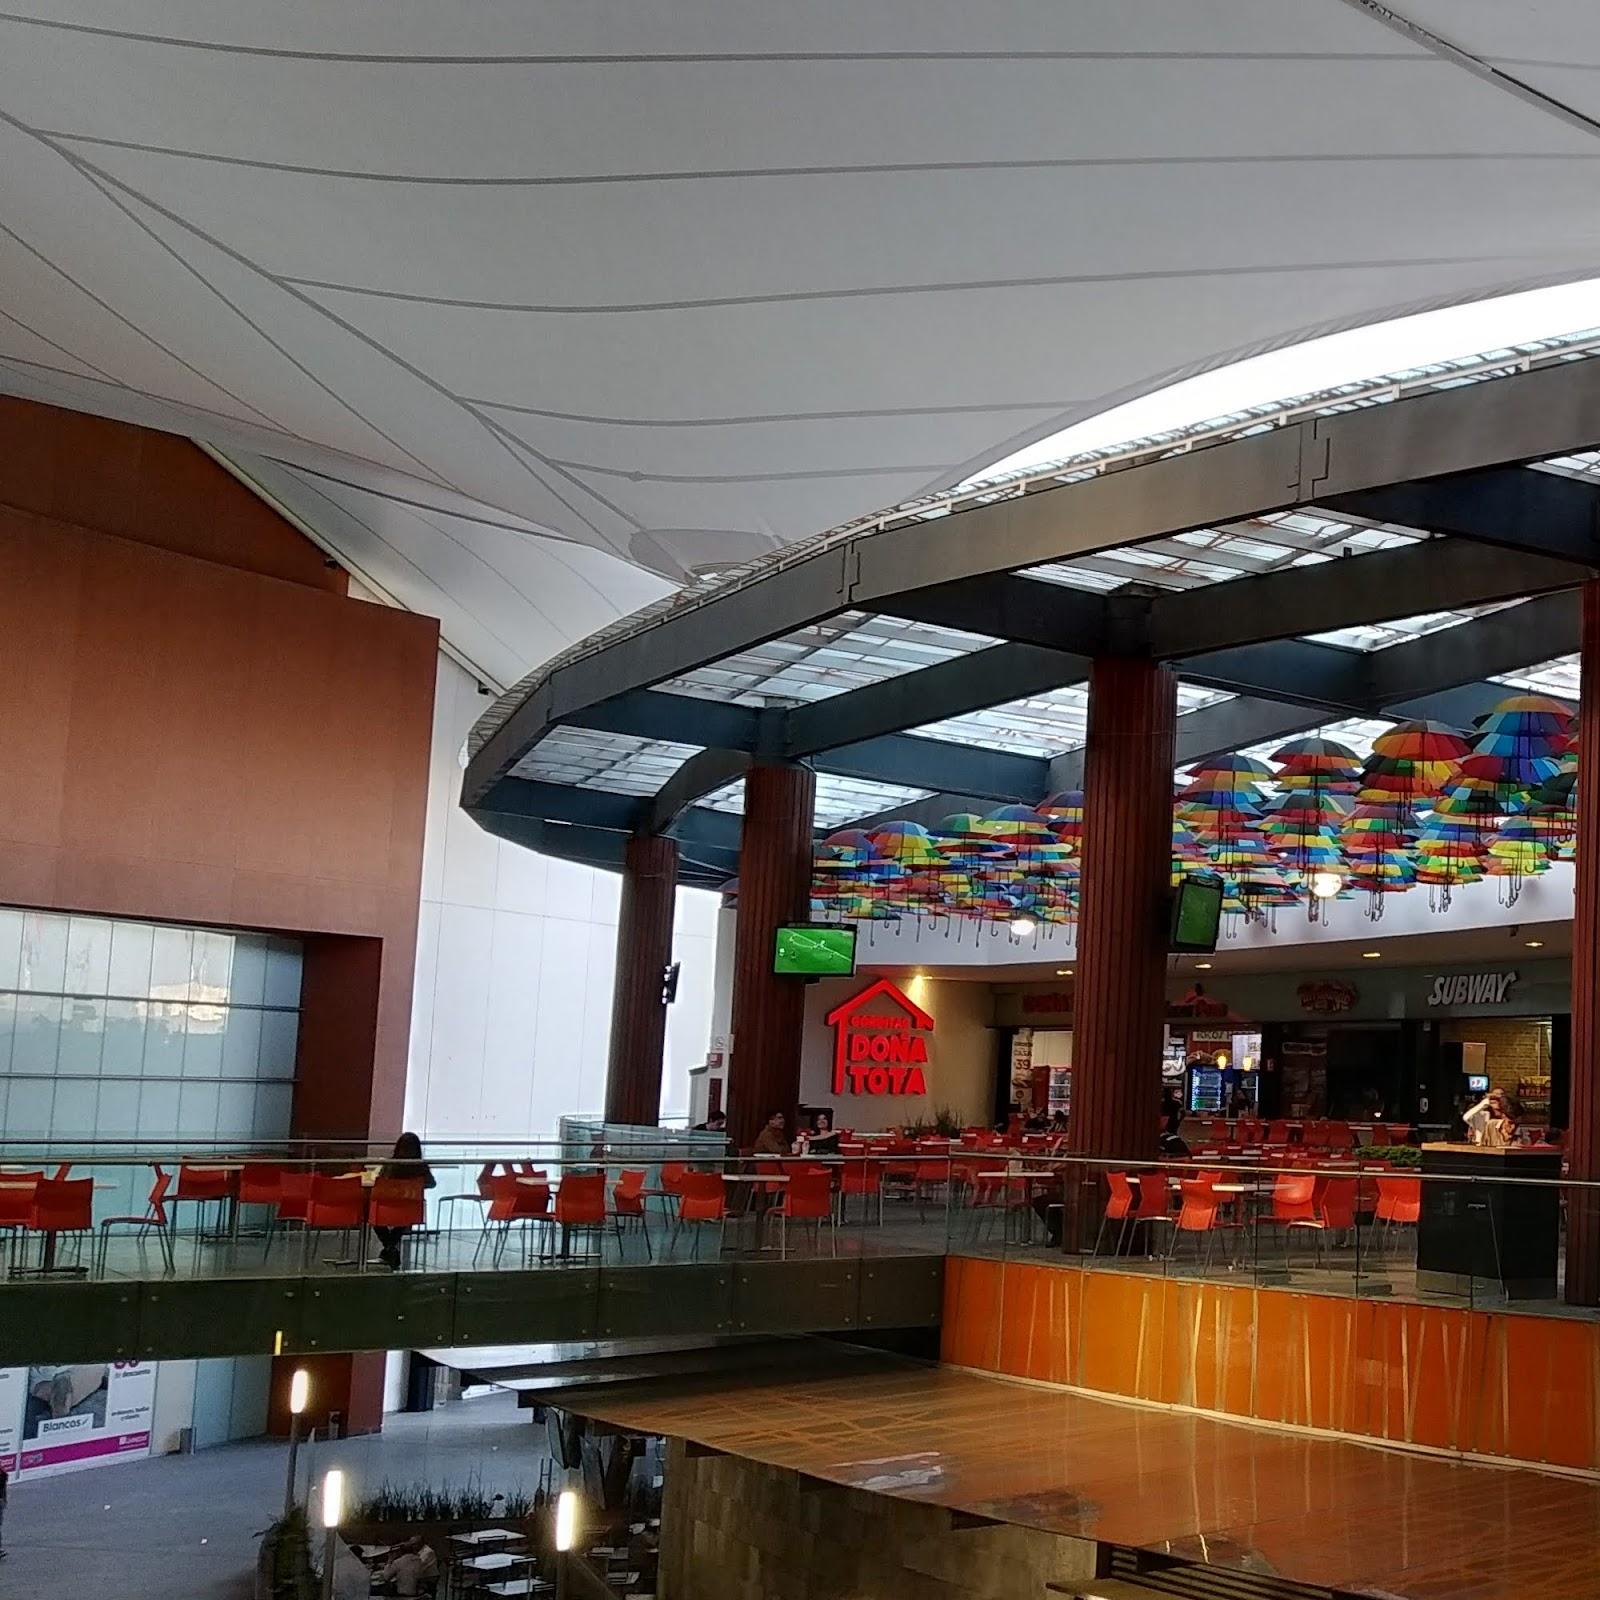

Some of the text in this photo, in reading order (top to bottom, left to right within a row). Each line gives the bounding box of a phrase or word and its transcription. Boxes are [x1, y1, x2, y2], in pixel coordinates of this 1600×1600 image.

[1428, 971, 1518, 1006] SUBWAY
[848, 1032, 928, 1063] DOÑA
[846, 1066, 927, 1095] TOTA
[43, 1420, 81, 1433] Blancos
